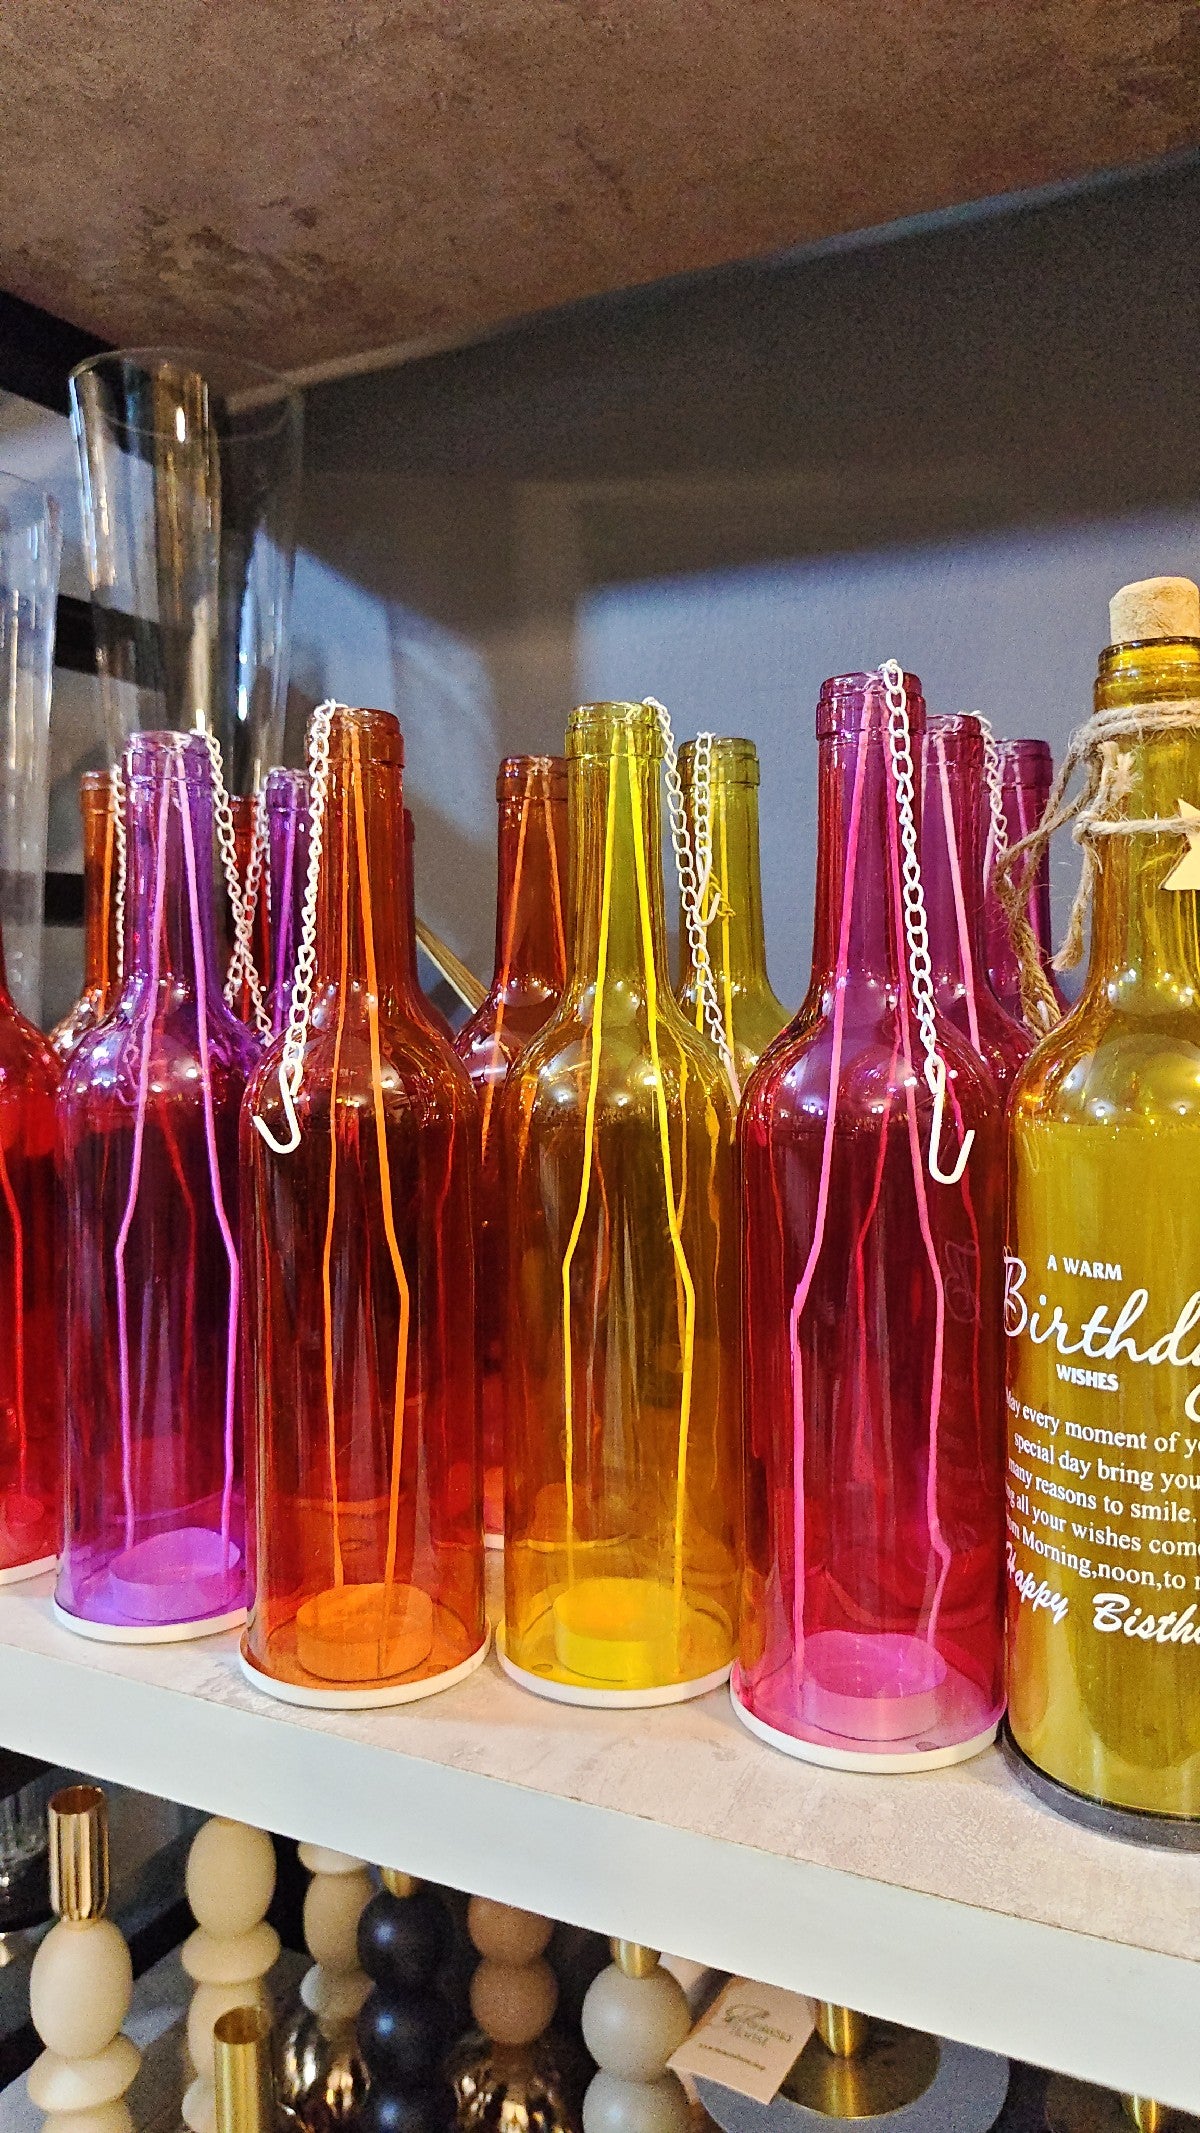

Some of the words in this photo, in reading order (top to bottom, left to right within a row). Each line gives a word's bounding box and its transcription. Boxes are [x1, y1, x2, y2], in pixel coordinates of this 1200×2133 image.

[1046, 1254, 1058, 1272] A
[1063, 1256, 1123, 1281] WARM
[1055, 1363, 1119, 1392] WISHES
[1022, 1405, 1060, 1436] every
[1065, 1421, 1147, 1450] moment
[1153, 1431, 1181, 1453] of
[1014, 1432, 1055, 1465] special
[1058, 1450, 1092, 1480] day
[1097, 1458, 1154, 1492] bring
[1008, 1457, 1033, 1490] many
[1035, 1476, 1097, 1510] reasons
[1103, 1495, 1124, 1516] to
[1130, 1501, 1198, 1524] smile.
[1016, 1493, 1030, 1516] all
[1032, 1505, 1067, 1533] your
[1071, 1521, 1142, 1551] wishes
[1148, 1538, 1200, 1557] com
